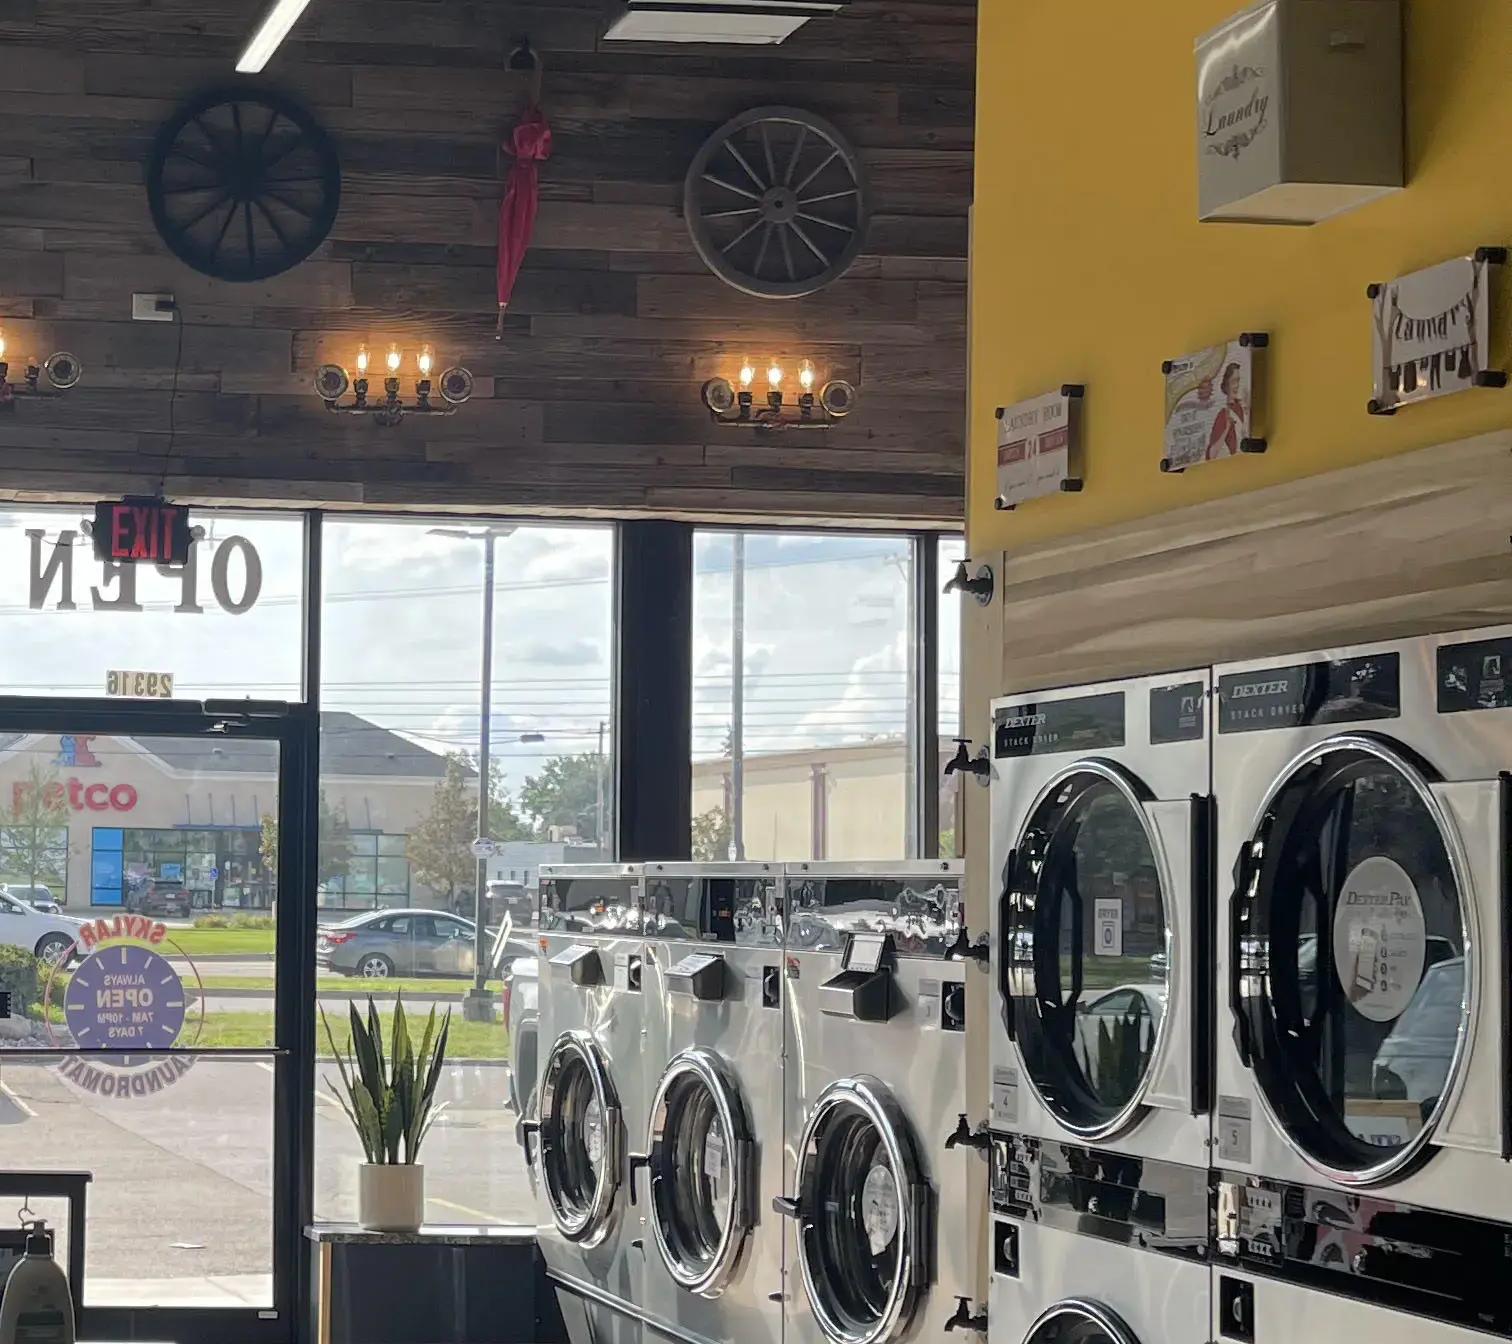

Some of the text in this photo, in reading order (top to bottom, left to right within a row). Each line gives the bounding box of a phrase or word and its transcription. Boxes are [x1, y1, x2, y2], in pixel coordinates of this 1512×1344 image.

[1204, 87, 1270, 137] Laundry
[111, 506, 178, 560] EXIT
[1231, 680, 1288, 699] DEXTER
[1005, 713, 1046, 729] DEXTER
[1230, 707, 1264, 720] STACK
[1003, 736, 1029, 747] STACK
